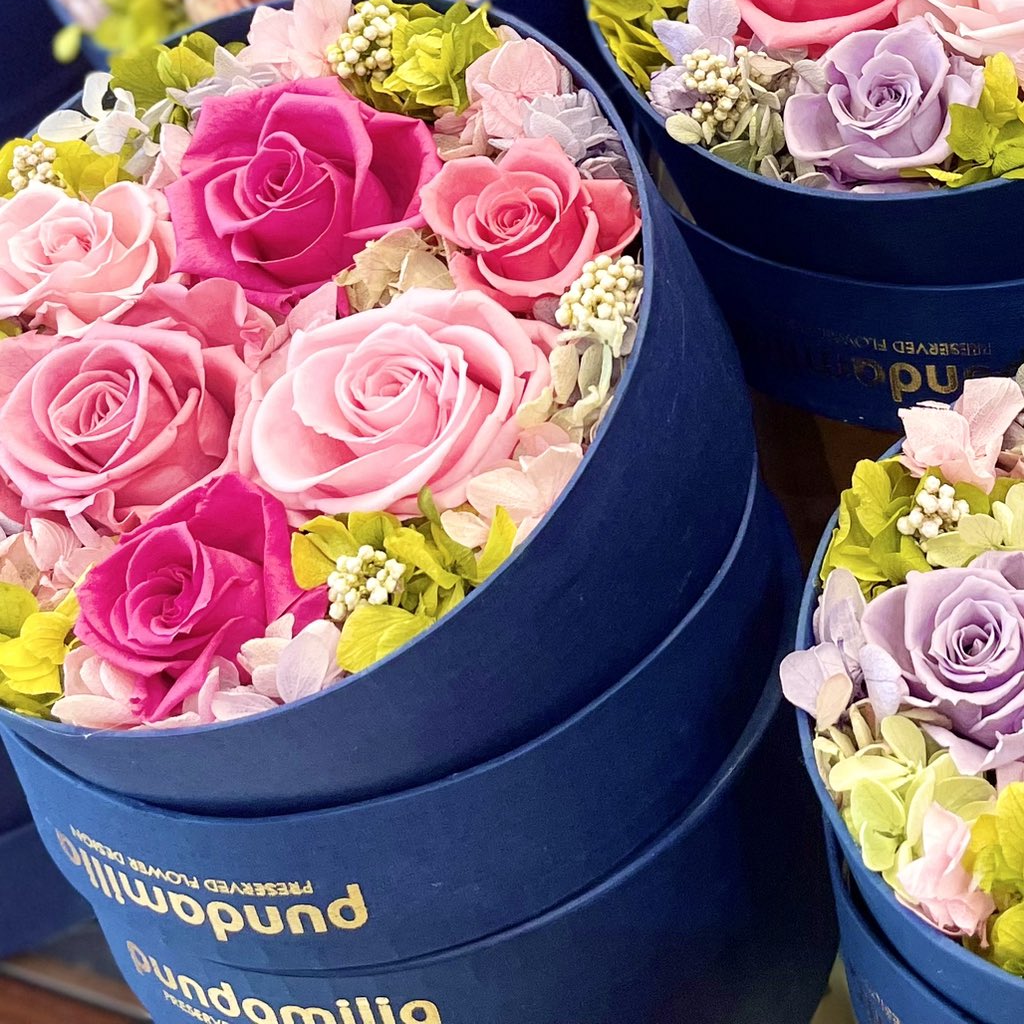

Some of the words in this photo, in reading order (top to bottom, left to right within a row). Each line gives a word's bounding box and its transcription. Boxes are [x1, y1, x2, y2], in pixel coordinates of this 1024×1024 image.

[127, 856, 200, 890] FLOWER
[204, 879, 314, 897] PRESERVED
[126, 939, 443, 1024] pundamilia
